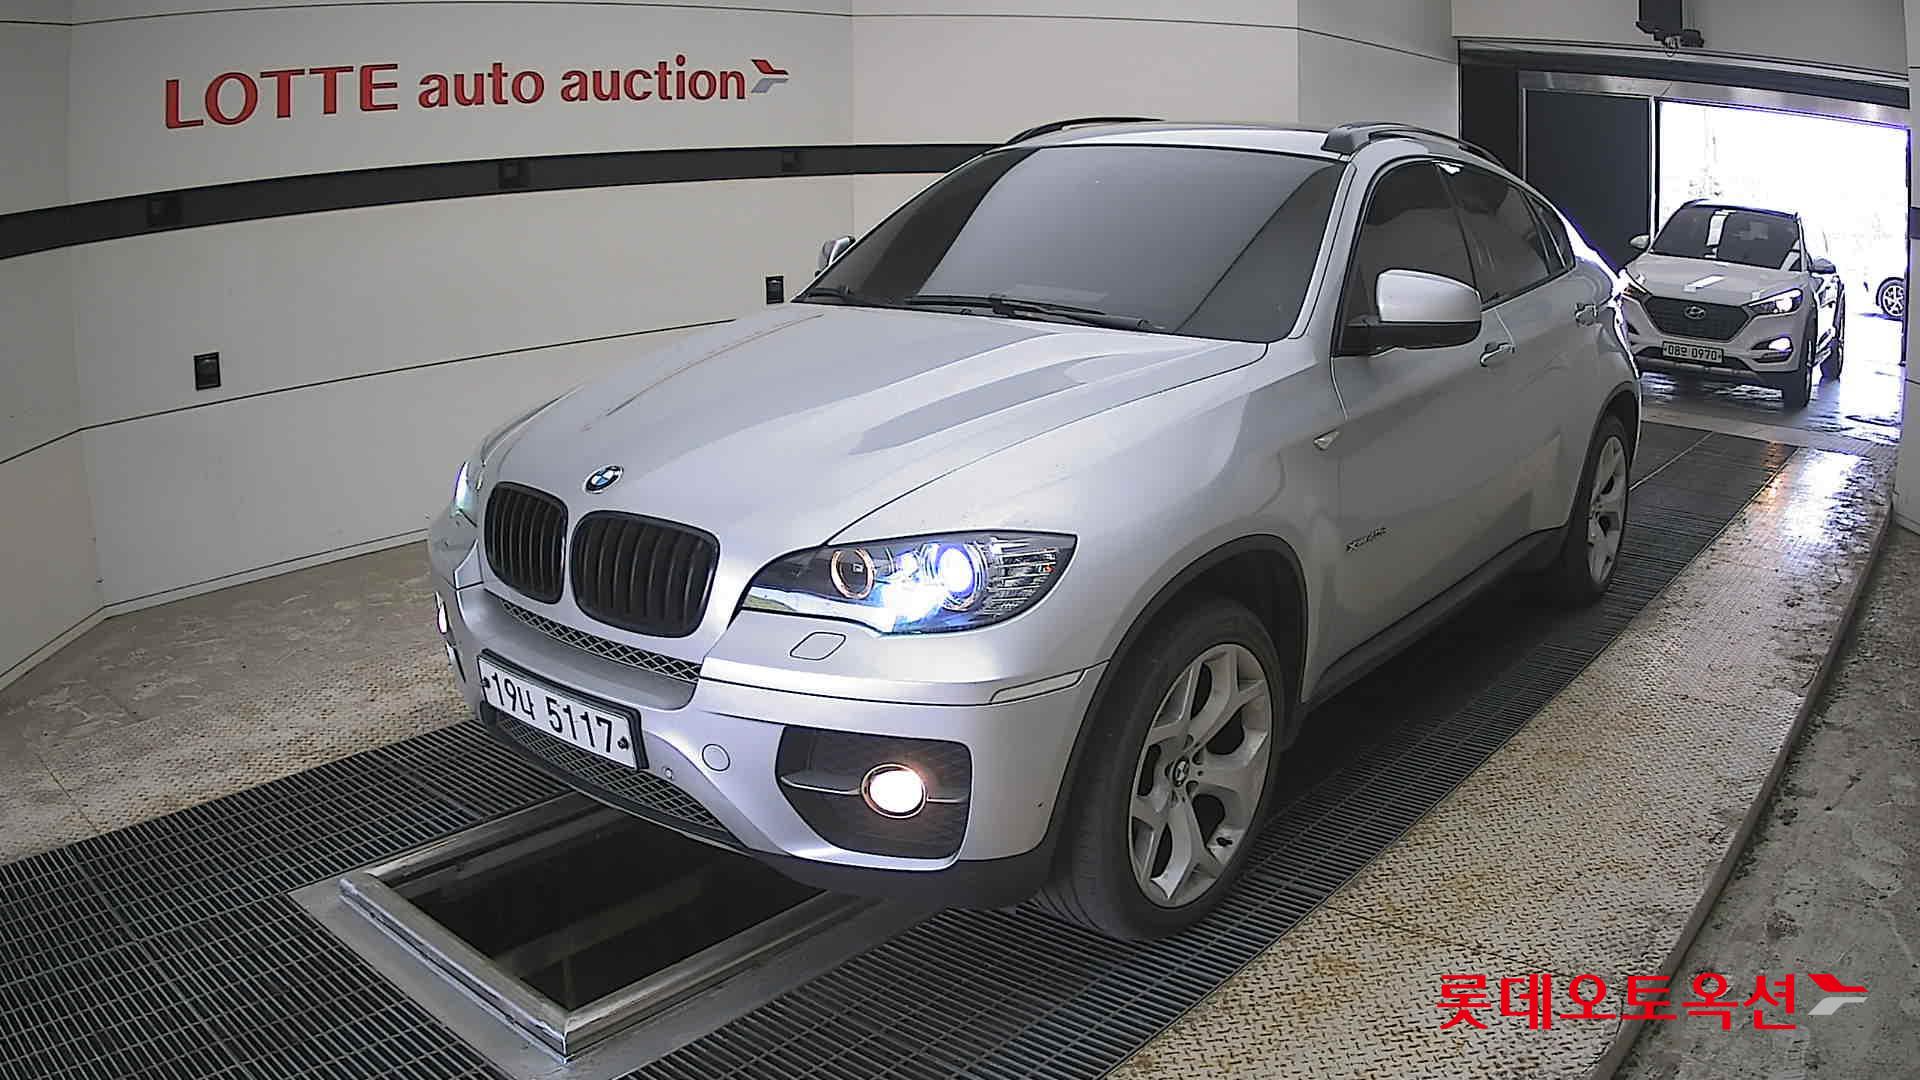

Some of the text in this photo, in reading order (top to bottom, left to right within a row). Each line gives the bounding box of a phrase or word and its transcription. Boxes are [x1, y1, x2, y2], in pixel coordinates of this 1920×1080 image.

[165, 55, 747, 130] LOTTE auto auction
[1692, 348, 1717, 361] 0970
[492, 672, 613, 753] 19나 5117
